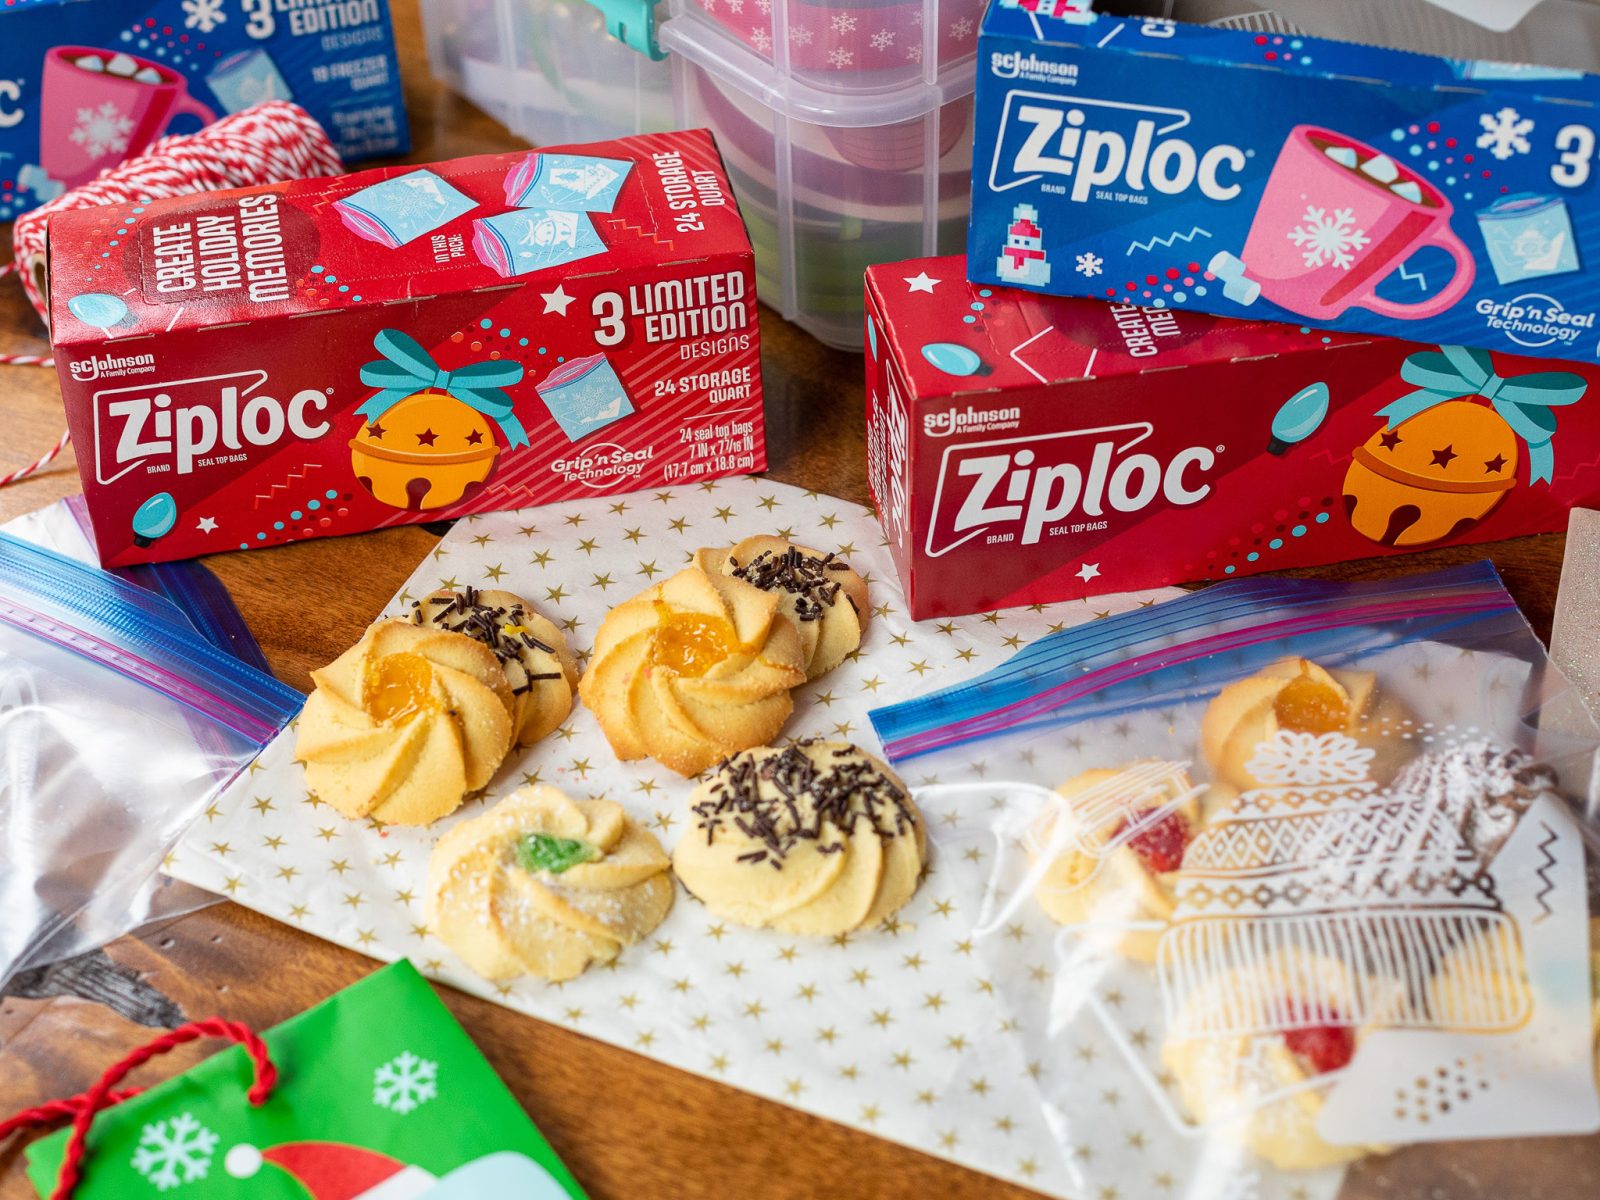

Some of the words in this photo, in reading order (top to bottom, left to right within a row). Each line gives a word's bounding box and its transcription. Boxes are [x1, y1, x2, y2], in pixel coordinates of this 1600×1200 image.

[289, 0, 380, 37] EDITION
[1012, 104, 1246, 203] Ziploc
[1550, 124, 1595, 187] 3
[653, 150, 697, 211] STORAGE
[691, 169, 726, 209] QUART
[1041, 183, 1066, 195] BRAND
[1095, 190, 1113, 201] SEAL
[1114, 192, 1129, 203] TOP
[1129, 194, 1149, 205] BAGS
[673, 209, 705, 233] 24
[196, 214, 242, 292] HOLIDAY
[239, 193, 290, 303] MEMORIES
[430, 234, 448, 254] THIS
[152, 222, 197, 293] CREATE
[629, 270, 746, 316] LIMITED
[591, 291, 626, 346] 3
[645, 301, 748, 343] EDITION
[1486, 315, 1581, 341] Technology
[1543, 306, 1596, 329] Seal
[1109, 304, 1158, 358] CREATE
[680, 334, 750, 360] DESIGNS
[106, 369, 126, 378] Family
[127, 365, 156, 375] Company
[654, 380, 677, 397] 24
[680, 366, 751, 393] STORAGE
[709, 383, 751, 404] QUART
[109, 386, 331, 475] Ziploc
[680, 428, 692, 444] 24
[694, 424, 713, 441] seal
[715, 424, 730, 441] top
[732, 420, 754, 438] bags
[963, 423, 986, 433] Family
[986, 420, 1020, 431] Company
[197, 456, 215, 468] SEAL
[215, 454, 229, 465] TOP
[229, 452, 248, 464] BAGS
[610, 446, 654, 465] Seal
[689, 445, 697, 459] 7
[698, 443, 708, 459] IN
[710, 446, 716, 456] x
[743, 436, 755, 451] IN
[146, 463, 171, 475] BRAND
[562, 462, 645, 483] Technology
[663, 462, 689, 482] (17.7
[690, 463, 704, 475] cm
[706, 463, 712, 473] x
[714, 455, 736, 471] 18.8
[737, 453, 755, 470] cm)
[953, 441, 1216, 545] Ziploc
[986, 532, 1014, 545] BRAND
[1048, 525, 1069, 537] SEAL
[1070, 524, 1086, 535] TOP
[1086, 520, 1108, 532] BAGS
